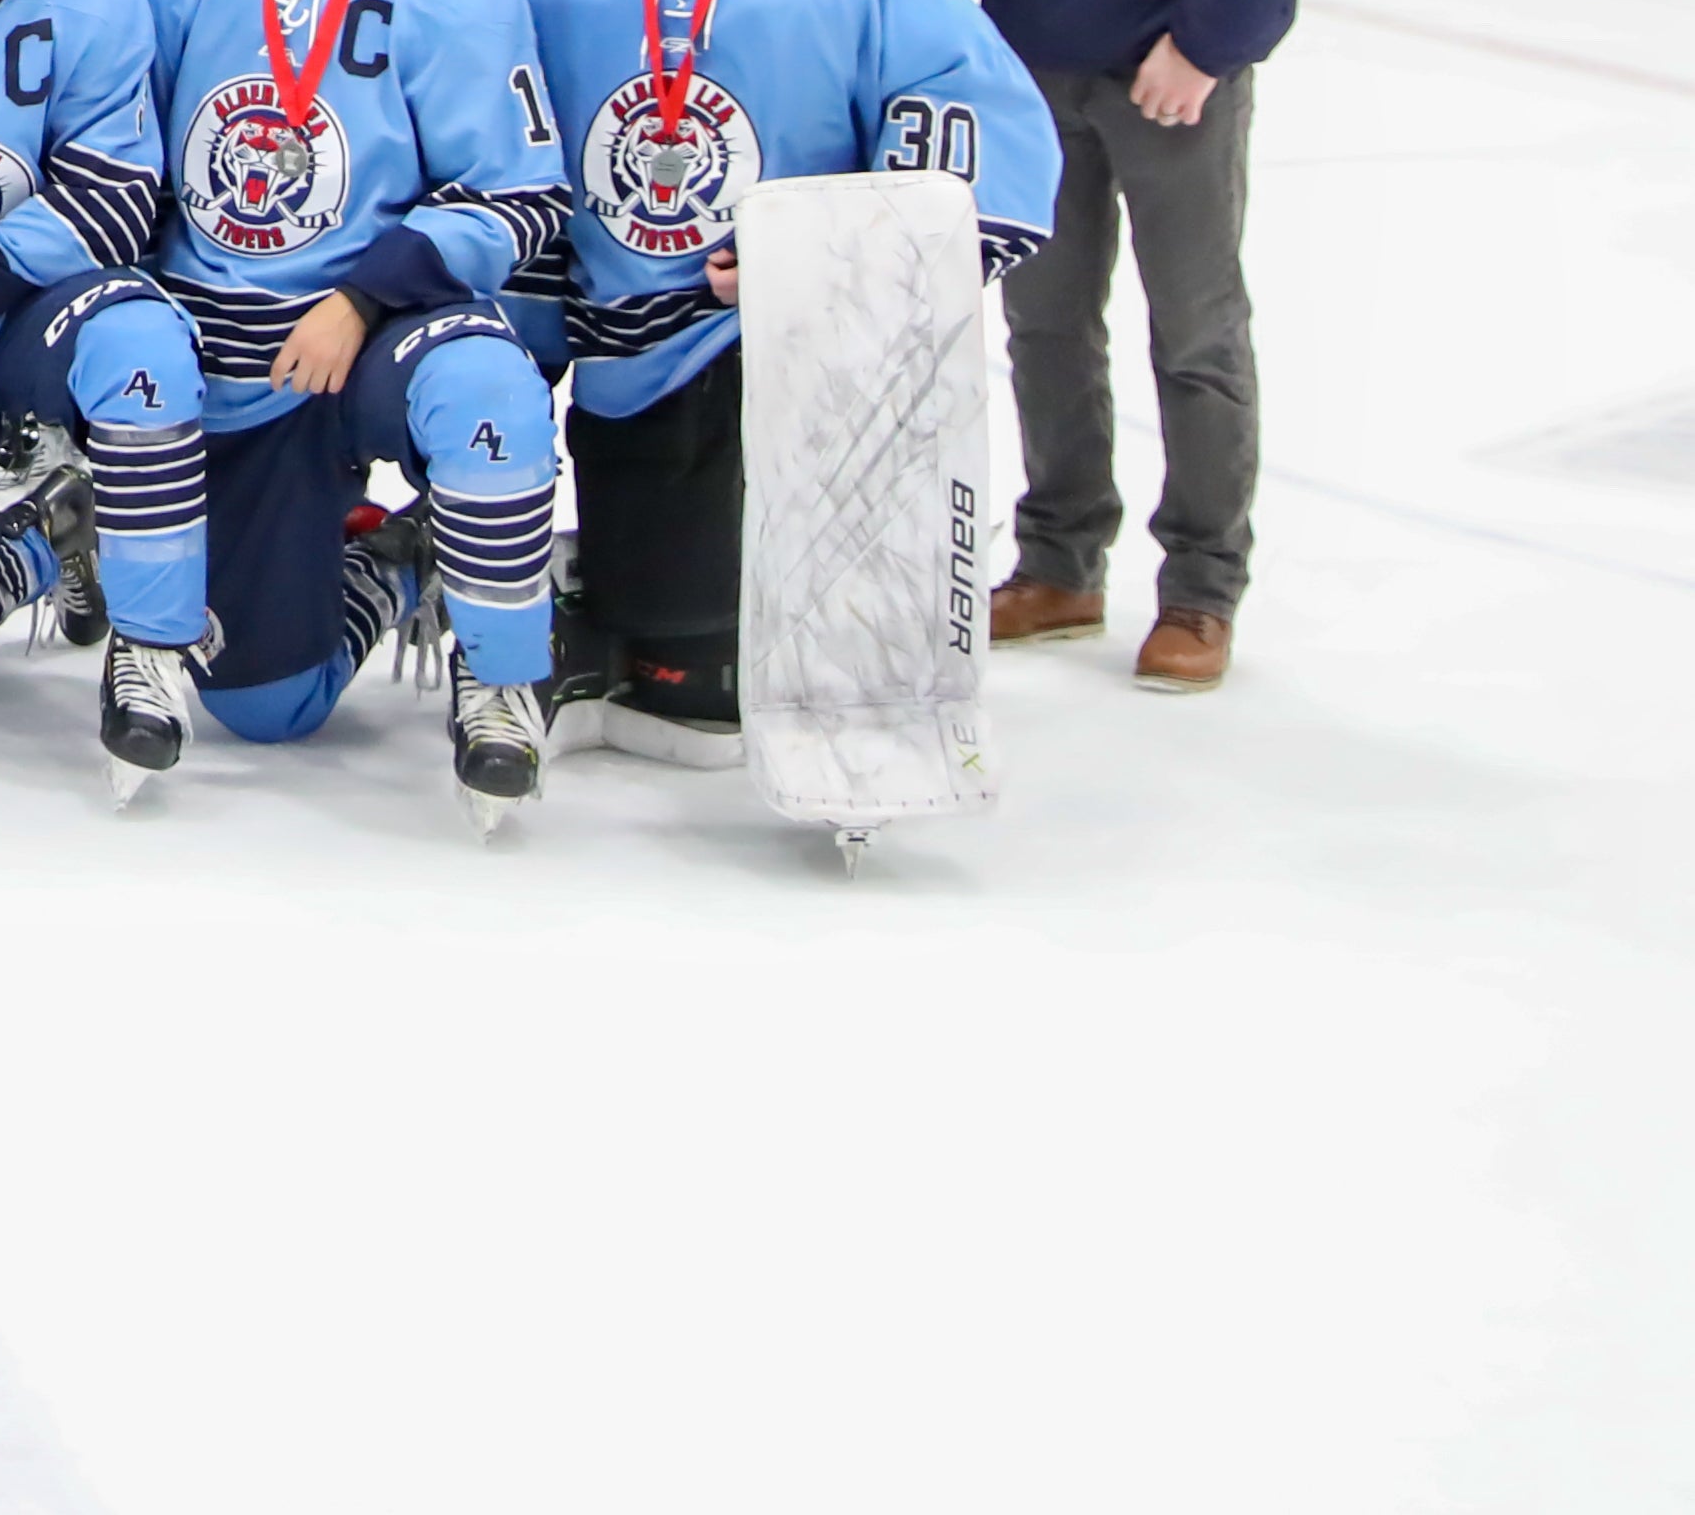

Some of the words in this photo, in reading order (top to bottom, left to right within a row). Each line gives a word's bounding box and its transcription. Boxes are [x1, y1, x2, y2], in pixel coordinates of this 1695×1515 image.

[5, 18, 53, 106] C
[693, 83, 737, 125] LEA
[885, 95, 980, 185] 30
[212, 218, 287, 249] TIGERS
[625, 220, 704, 249] TIGERS
[393, 313, 507, 363] CCM
[954, 722, 985, 772] 3X
